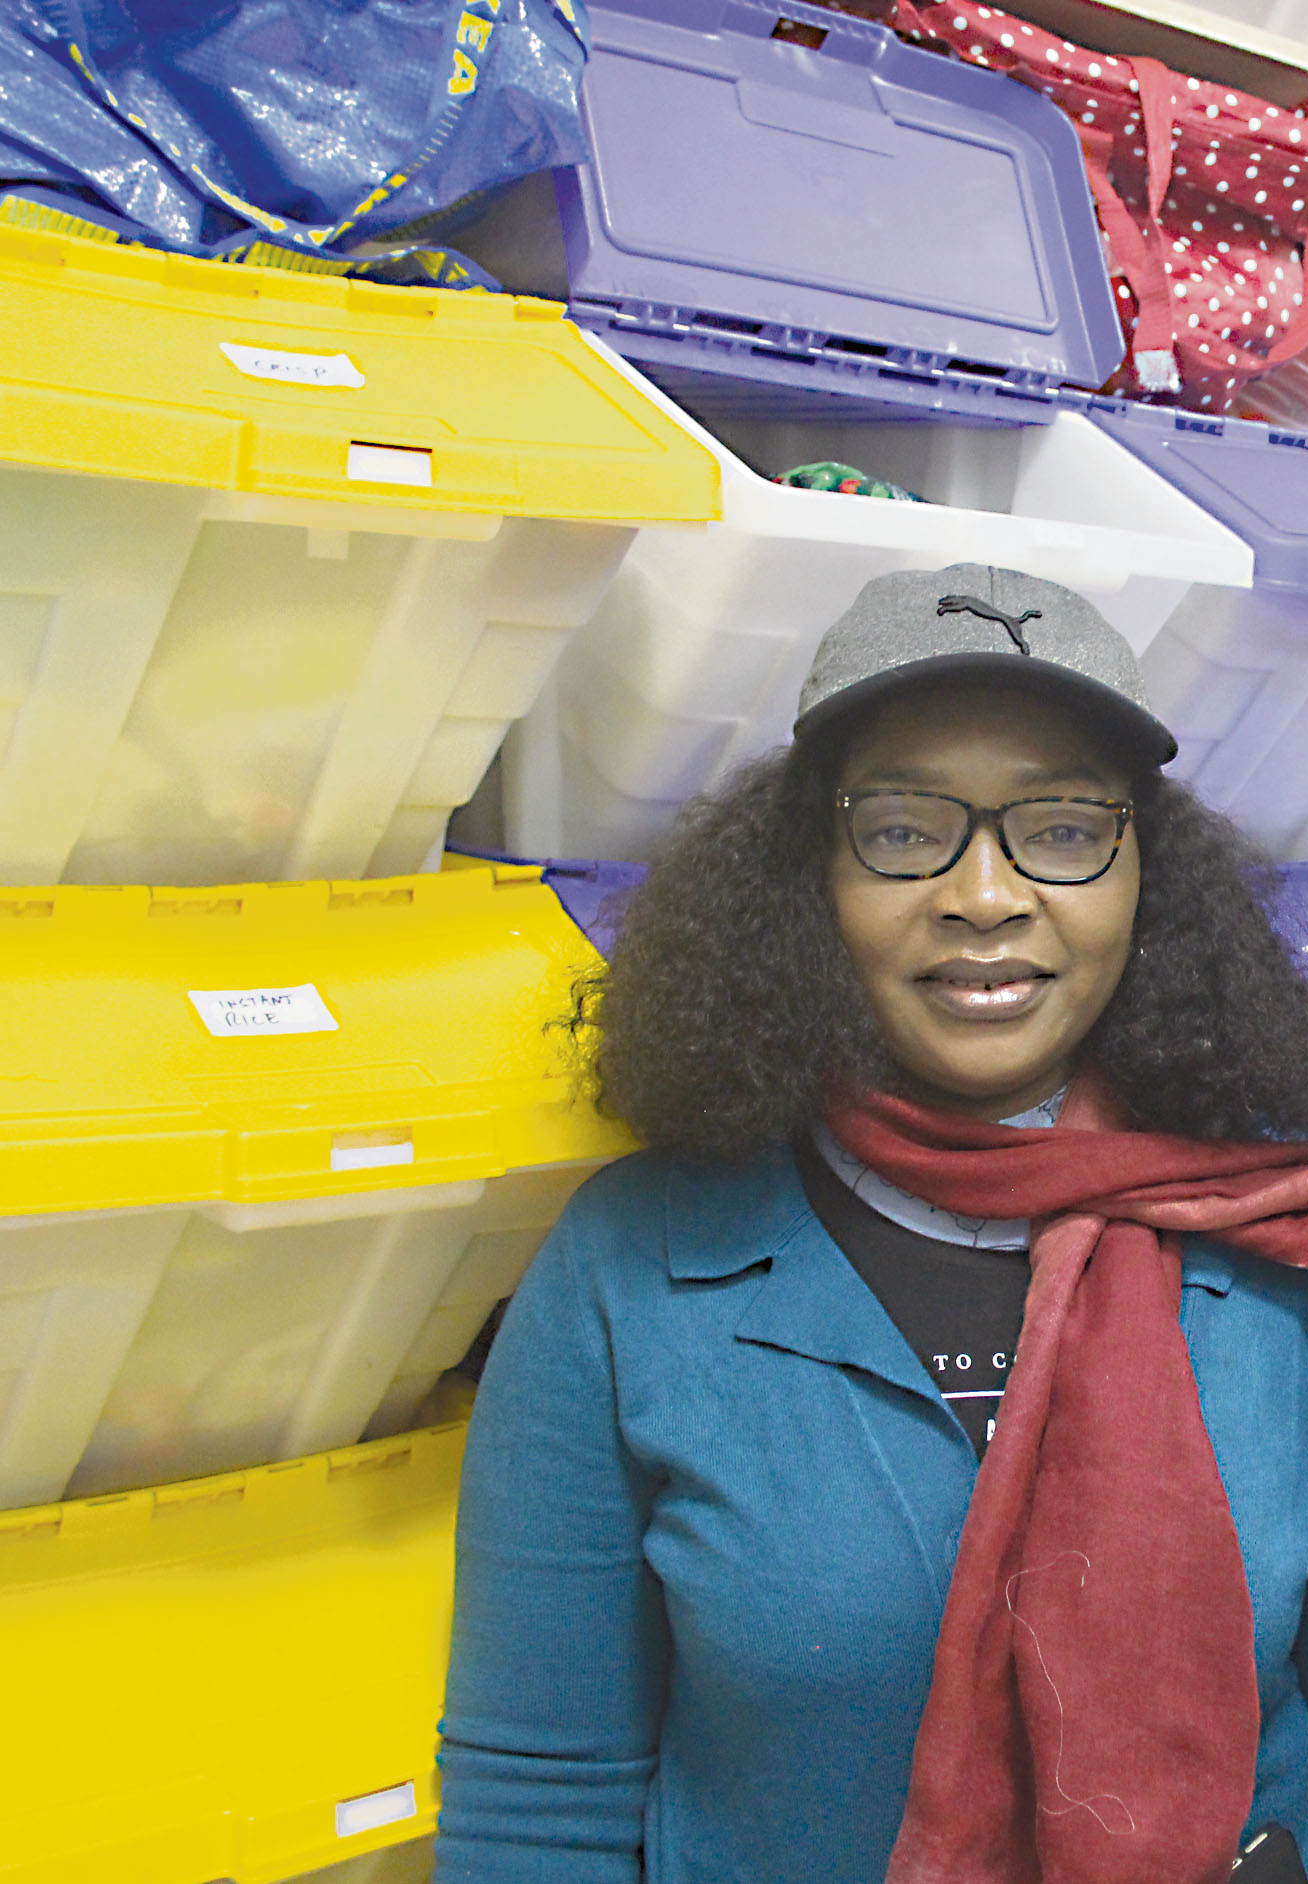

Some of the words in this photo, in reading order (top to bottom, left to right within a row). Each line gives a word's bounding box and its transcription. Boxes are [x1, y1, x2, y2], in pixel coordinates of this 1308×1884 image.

[219, 994, 294, 1009] INSTANT
[225, 1011, 280, 1027] RICE
[933, 1354, 972, 1371] TO
[992, 1352, 1018, 1369] C
